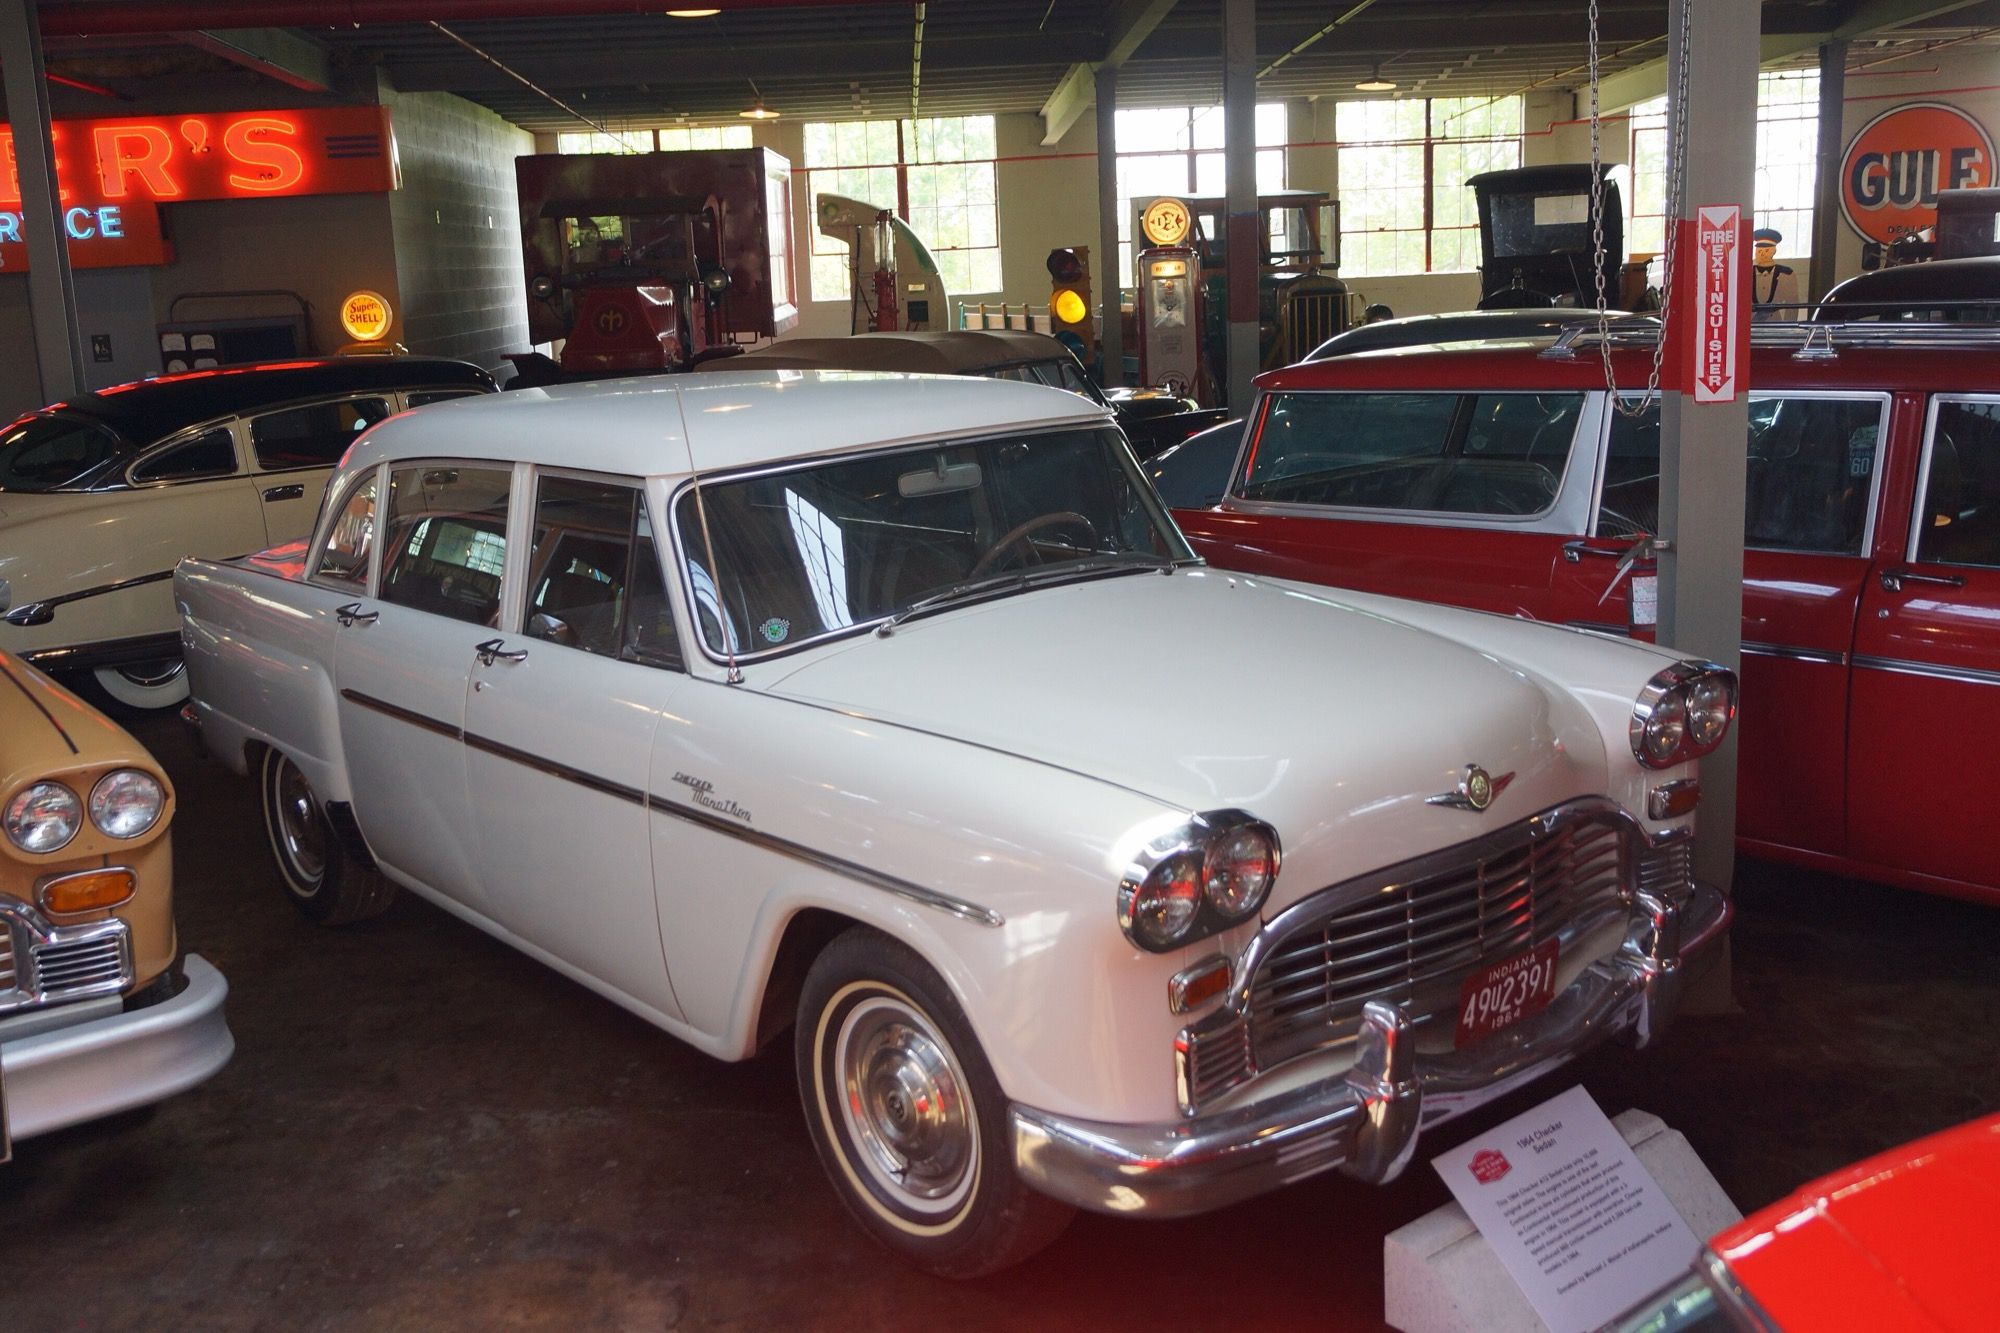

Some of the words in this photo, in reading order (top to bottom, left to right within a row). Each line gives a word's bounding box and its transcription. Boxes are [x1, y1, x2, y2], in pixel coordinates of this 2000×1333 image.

[1852, 147, 1983, 211] GULF
[0, 206, 124, 243] RCE
[1702, 230, 1734, 244] FIRE
[350, 302, 376, 314] Super
[350, 314, 380, 324] SHELL
[1708, 244, 1725, 387] EXTINGUISHER
[1488, 953, 1537, 983] INDIANA
[1462, 957, 1552, 1029] 49U2391
[1534, 1121, 1562, 1139] Checker
[1533, 1139, 1557, 1153] Sedan
